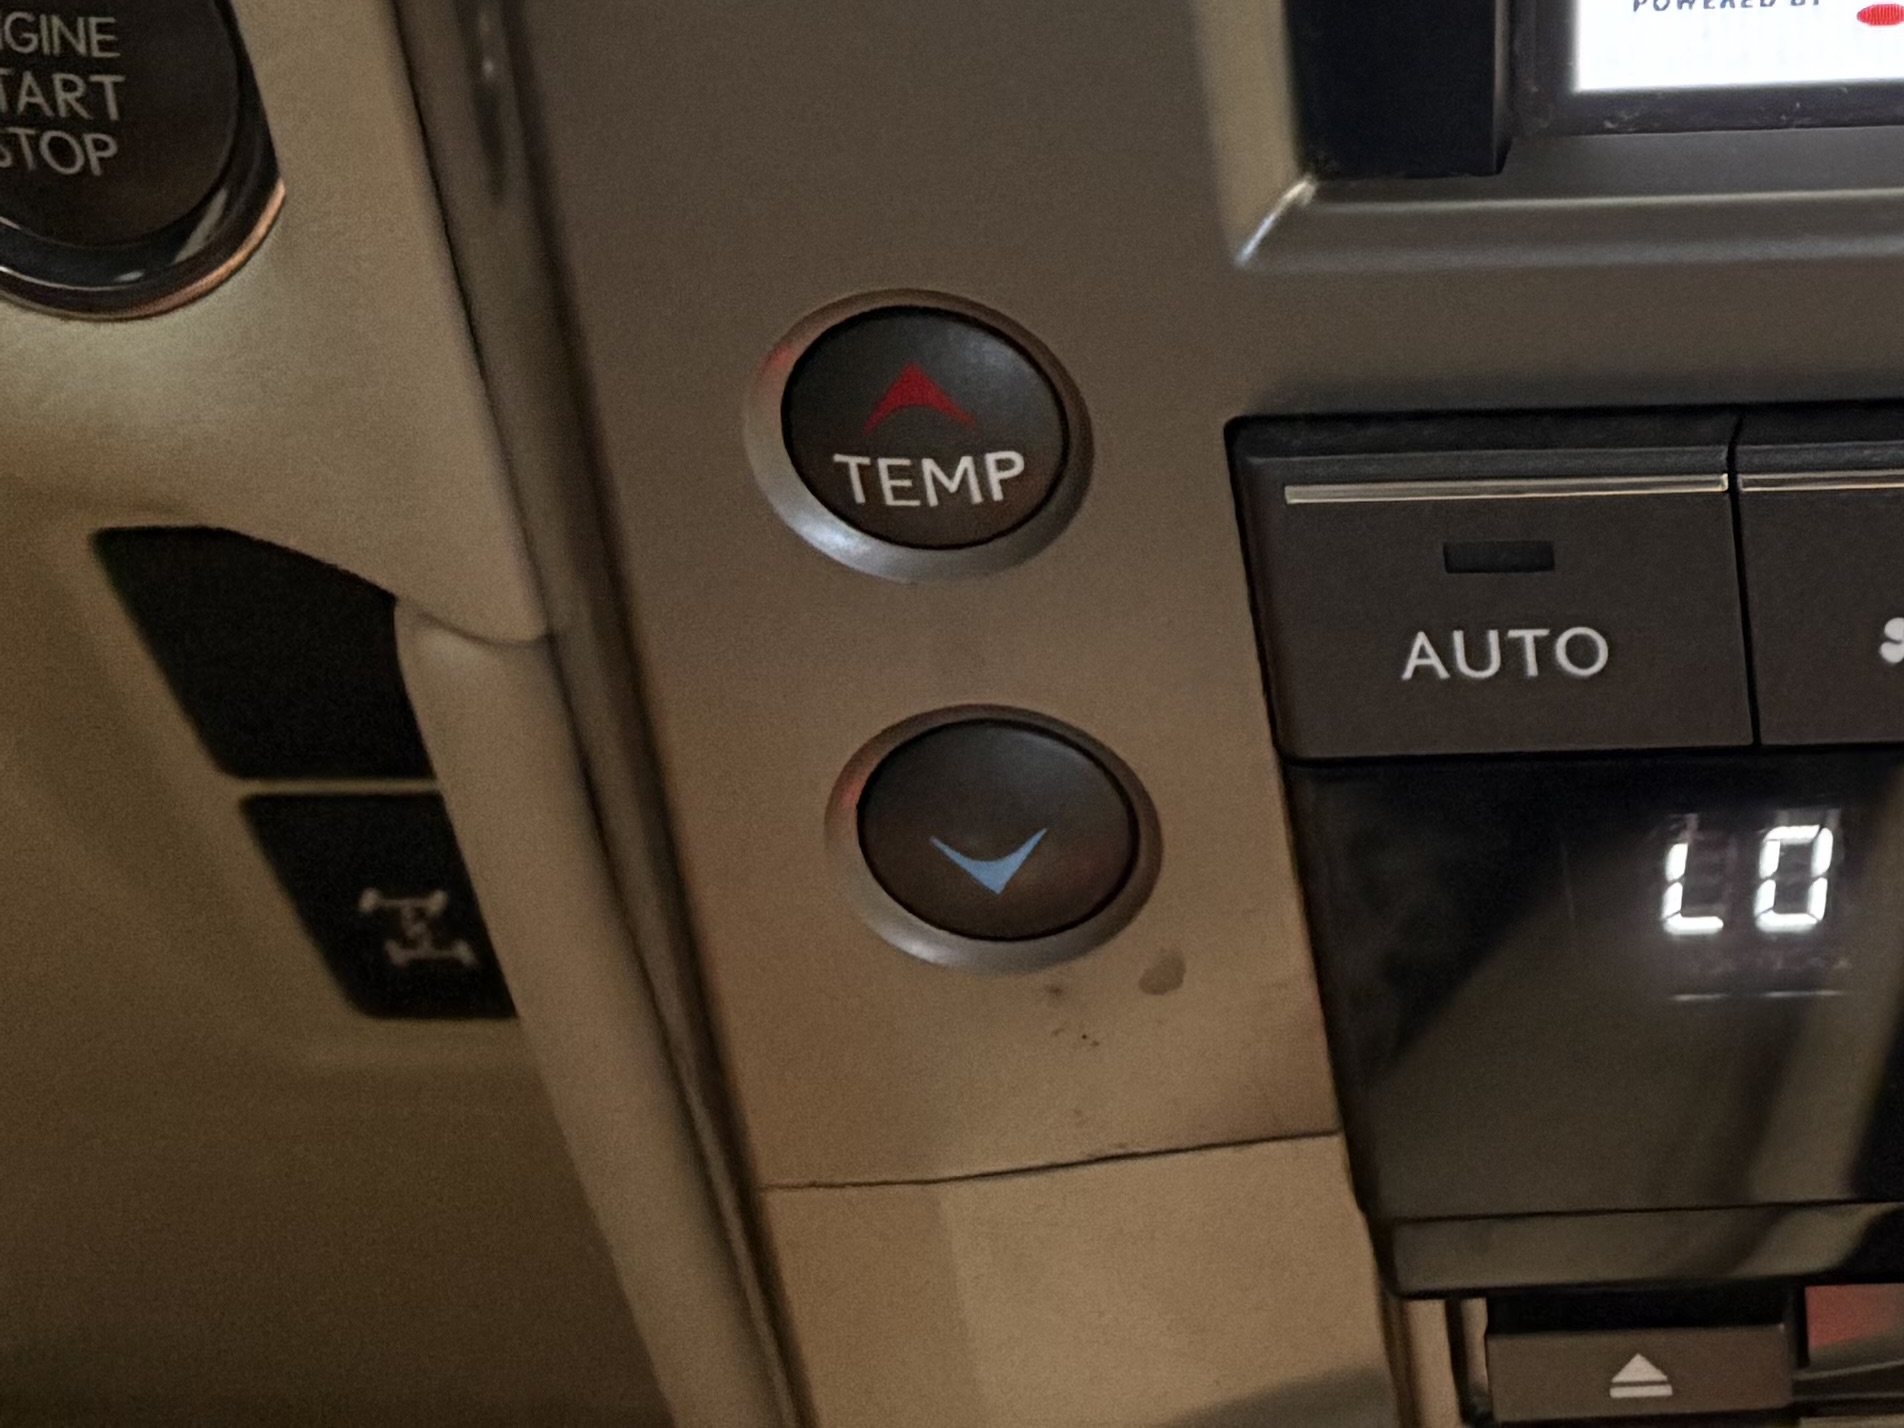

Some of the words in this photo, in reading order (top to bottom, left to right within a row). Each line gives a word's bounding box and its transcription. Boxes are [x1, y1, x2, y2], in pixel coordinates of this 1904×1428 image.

[0, 10, 120, 59] GINE
[831, 450, 1027, 508] TEMP
[1401, 625, 1610, 681] AUTO
